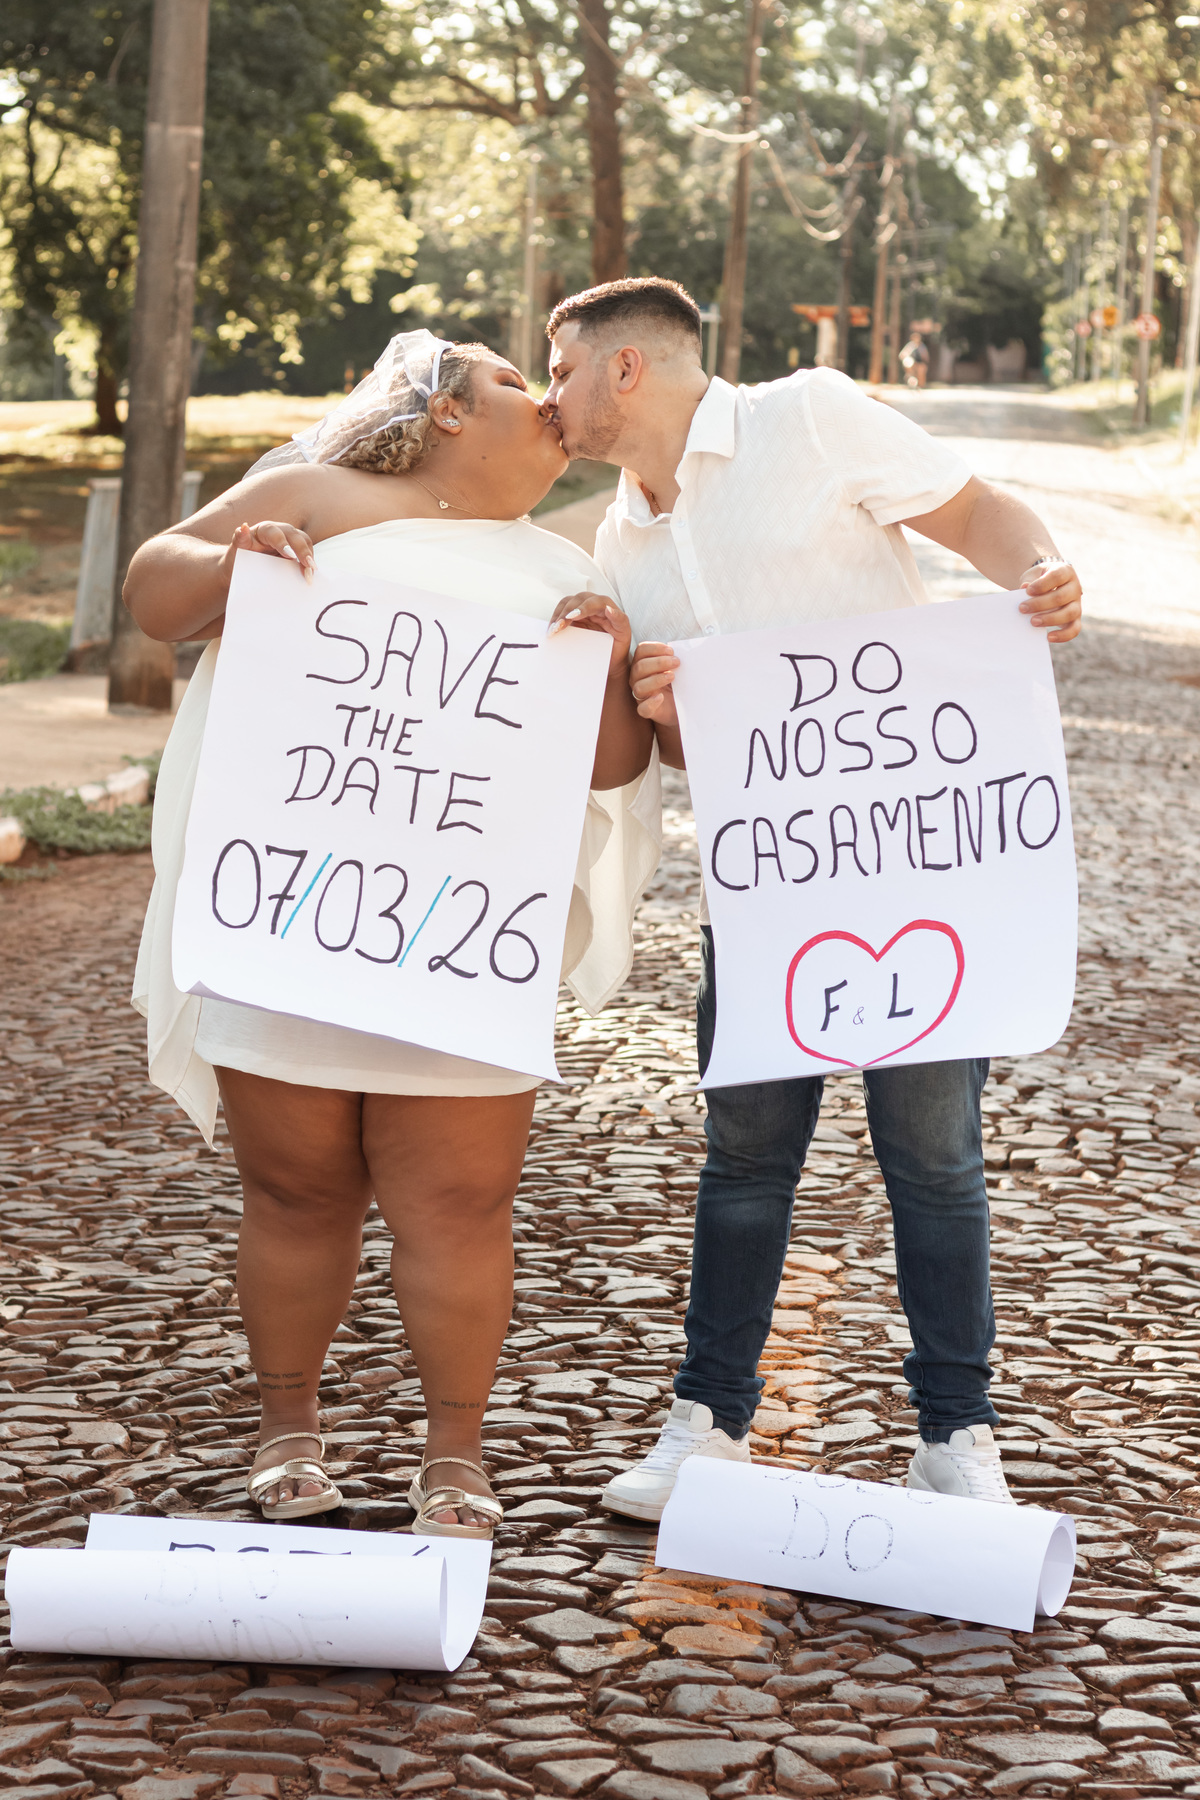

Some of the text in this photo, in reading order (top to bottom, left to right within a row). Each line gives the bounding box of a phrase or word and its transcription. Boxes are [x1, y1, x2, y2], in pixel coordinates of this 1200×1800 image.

[306, 599, 539, 730] SAVE
[779, 641, 903, 713] DO
[335, 703, 423, 757] THE
[743, 701, 978, 789] NOSSO
[284, 745, 492, 835] DATE
[710, 770, 1061, 892] CASAMENTO
[211, 838, 548, 984] 07/03/26
[819, 972, 915, 1032] F & L
[441, 1399, 467, 1409] MATEUS
